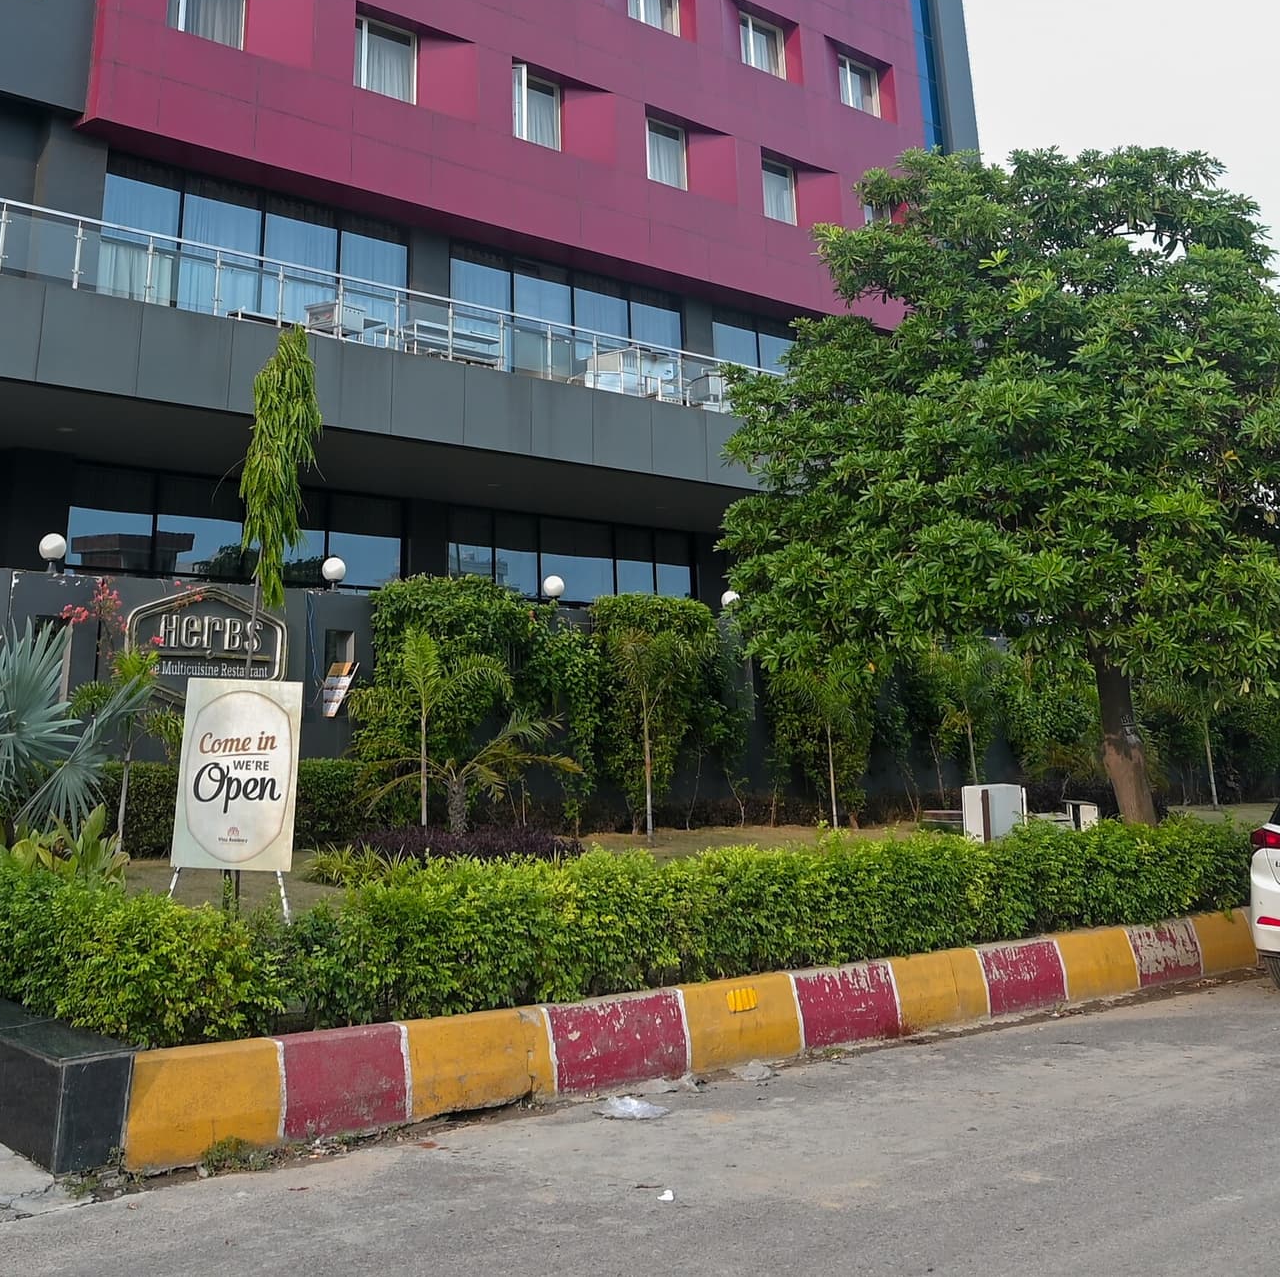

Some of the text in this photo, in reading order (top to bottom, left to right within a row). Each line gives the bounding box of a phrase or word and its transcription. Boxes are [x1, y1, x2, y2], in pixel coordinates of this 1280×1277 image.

[161, 660, 219, 676] Multicuisine
[221, 662, 268, 678] Restarant
[199, 731, 277, 754] Come in
[232, 760, 269, 771] WE'RE
[193, 762, 281, 814] Open
